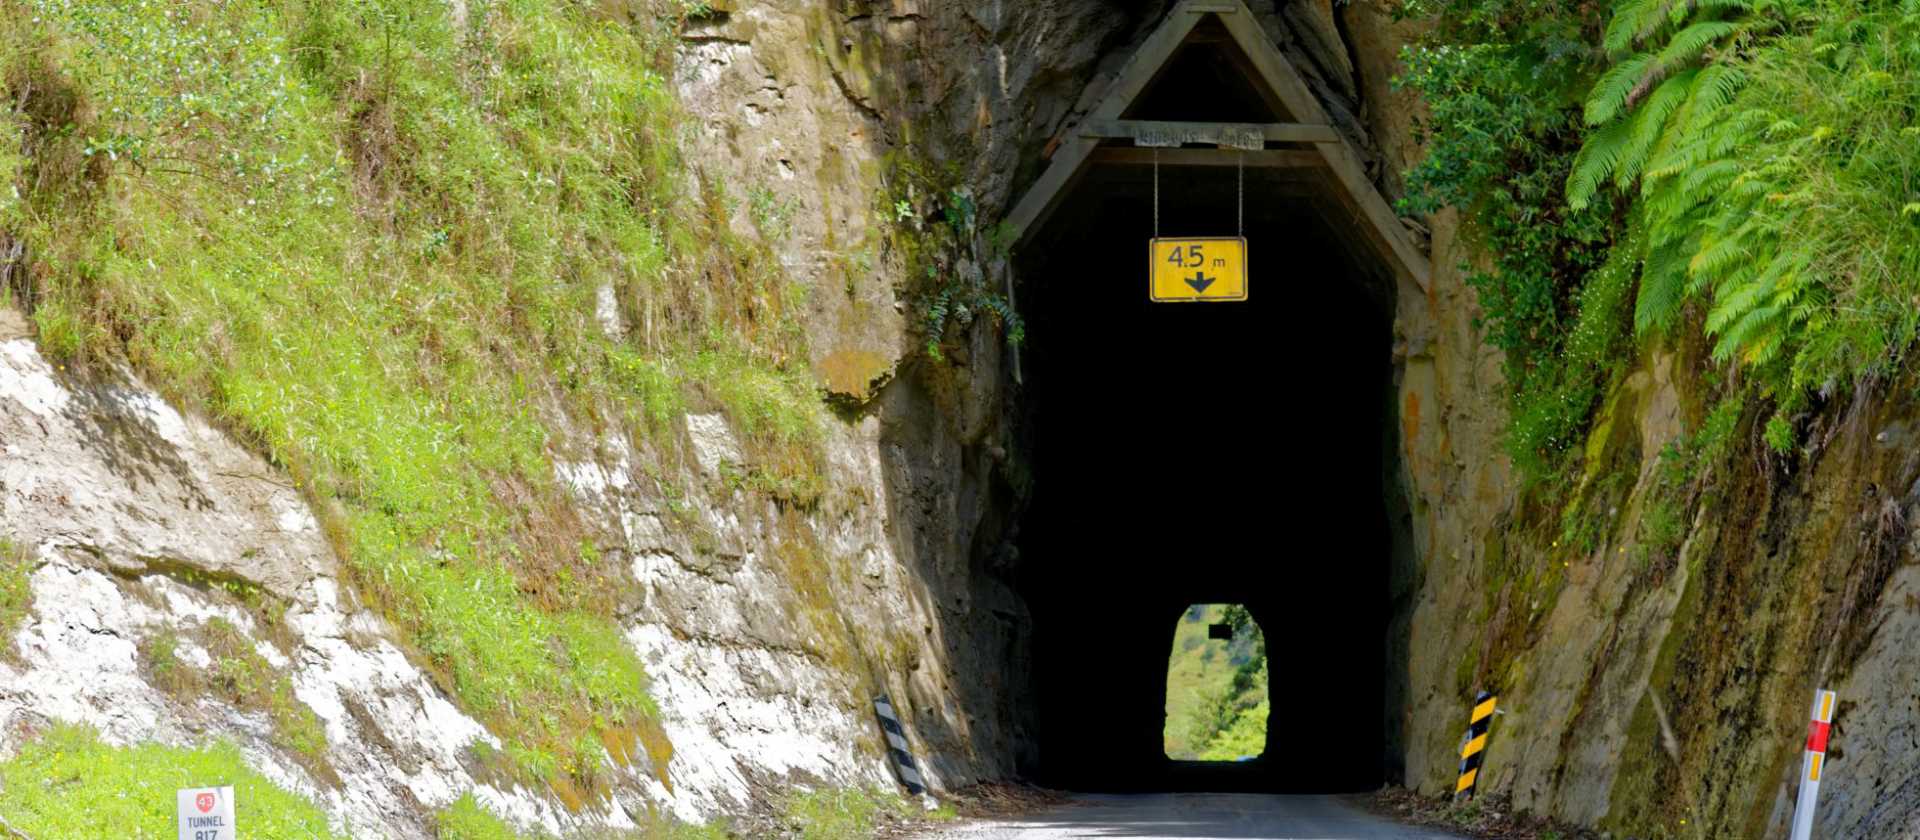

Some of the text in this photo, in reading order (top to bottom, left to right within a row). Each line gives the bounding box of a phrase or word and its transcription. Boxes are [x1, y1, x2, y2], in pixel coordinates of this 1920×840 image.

[1168, 245, 1226, 268] 4.5 m
[199, 798, 213, 808] 43
[187, 816, 225, 828] TUNNEL
